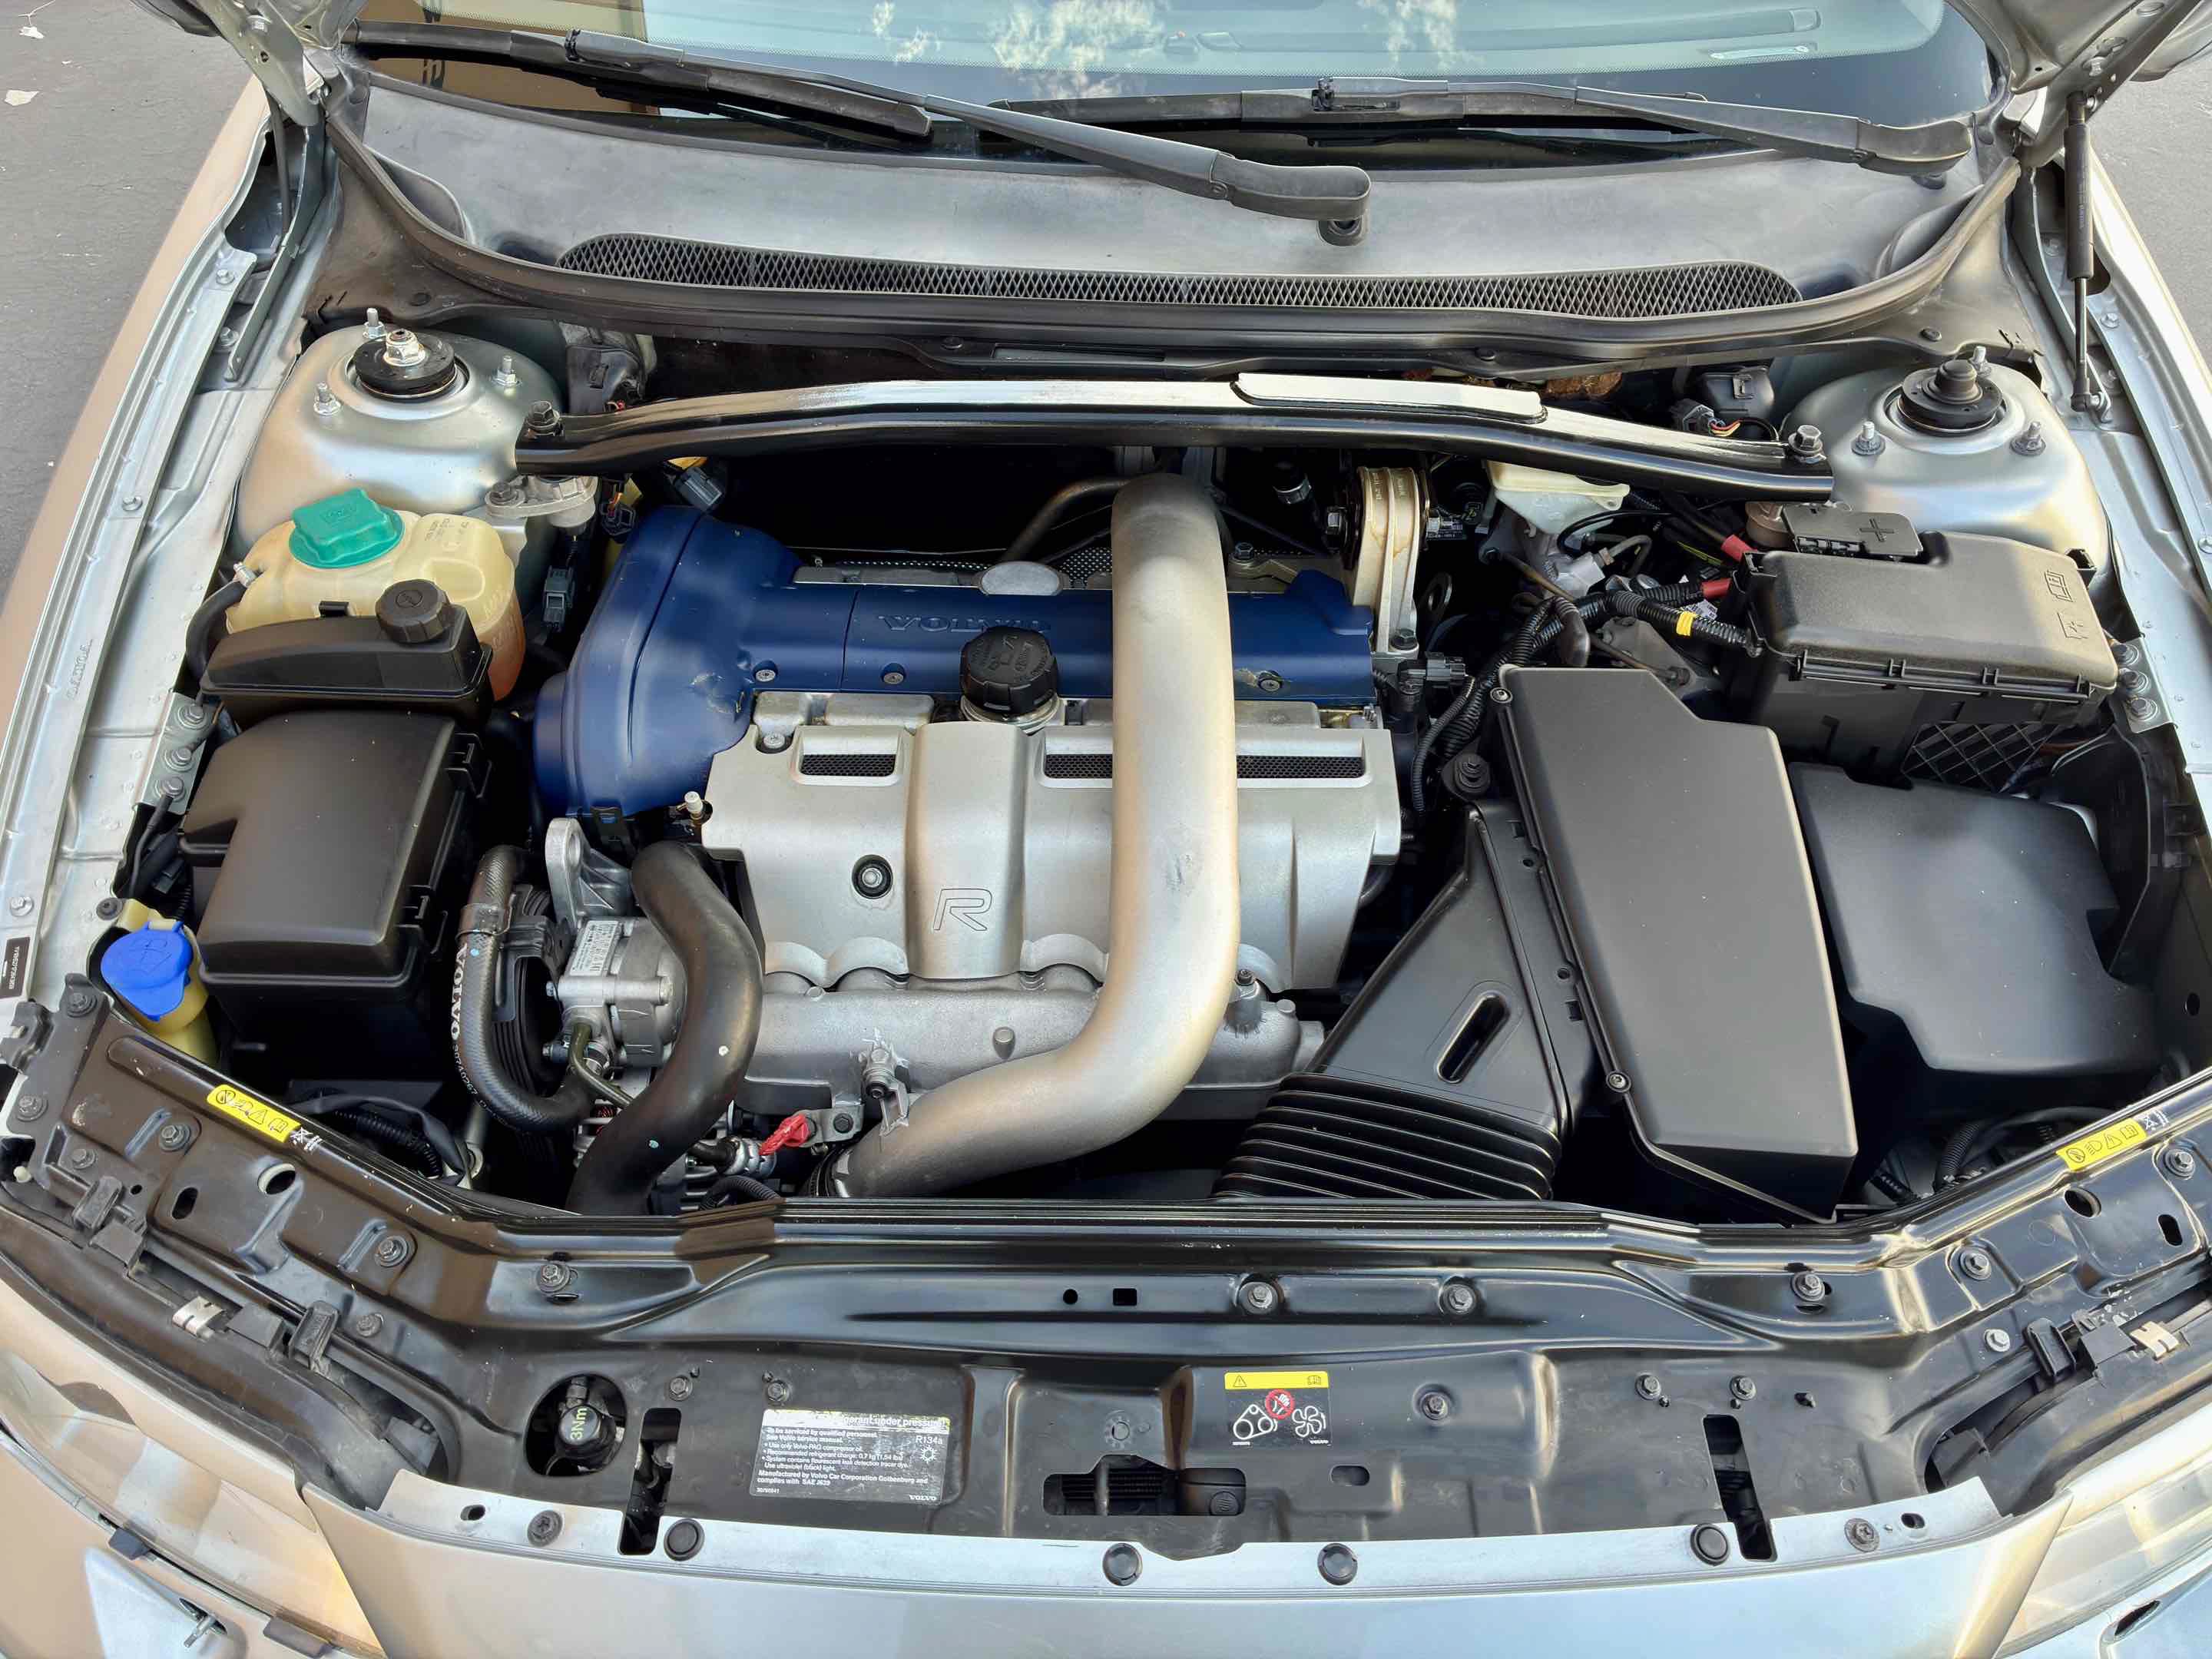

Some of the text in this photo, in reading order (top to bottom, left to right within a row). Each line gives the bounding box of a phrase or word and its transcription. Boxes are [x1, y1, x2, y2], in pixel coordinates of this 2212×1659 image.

[932, 888, 993, 932] R
[450, 943, 467, 1041] VOLVO
[916, 1435, 944, 1445] R134a
[758, 1469, 800, 1478] Manufactured
[878, 1476, 915, 1485] Gothenburg
